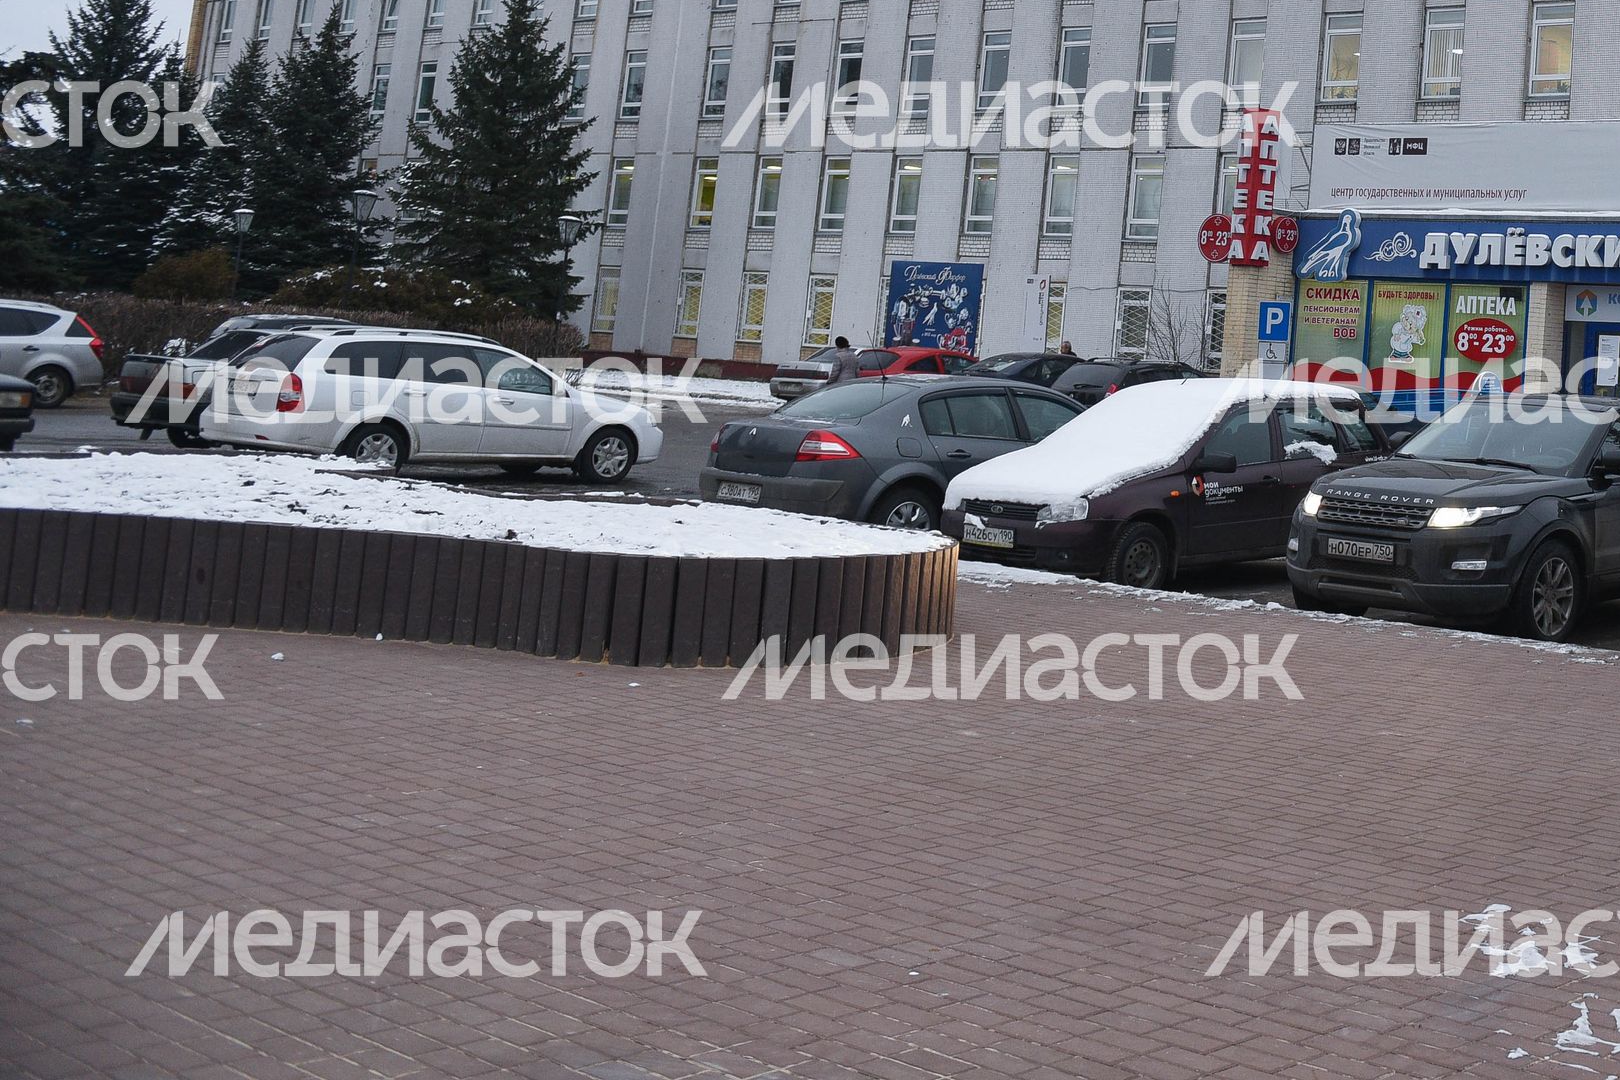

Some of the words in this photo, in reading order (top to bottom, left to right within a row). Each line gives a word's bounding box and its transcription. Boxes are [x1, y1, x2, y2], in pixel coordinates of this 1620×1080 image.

[1406, 142, 1423, 151] МФЦ
[1228, 113, 1255, 260] АПТЕКА
[1250, 115, 1280, 261] АПТЕКА
[1331, 188, 1354, 200] центр
[1355, 187, 1424, 200] государственных
[1426, 189, 1432, 198] и
[1433, 187, 1503, 201] муниципальных
[1504, 188, 1527, 202] услуг
[1306, 288, 1361, 302] СКИДКА
[1378, 290, 1402, 300] БУДЬТЕ
[1303, 306, 1361, 315] ПЕНСИОНЕРАМ
[1456, 296, 1517, 317] АПТЕКА
[1304, 317, 1310, 325] И
[1311, 317, 1357, 326] ВЕТЕРАНАМ
[1333, 327, 1357, 340] ВОВ
[1463, 324, 1482, 333] Режим
[1483, 325, 1508, 335] работы:
[1205, 486, 1243, 497] документы
[1327, 488, 1371, 499] RANGE
[1380, 494, 1435, 504] ROVER
[965, 527, 998, 541] Н426СУ
[999, 529, 1012, 541] 190
[1330, 541, 1372, 557] Н070ЕР
[1373, 544, 1391, 556] 750
